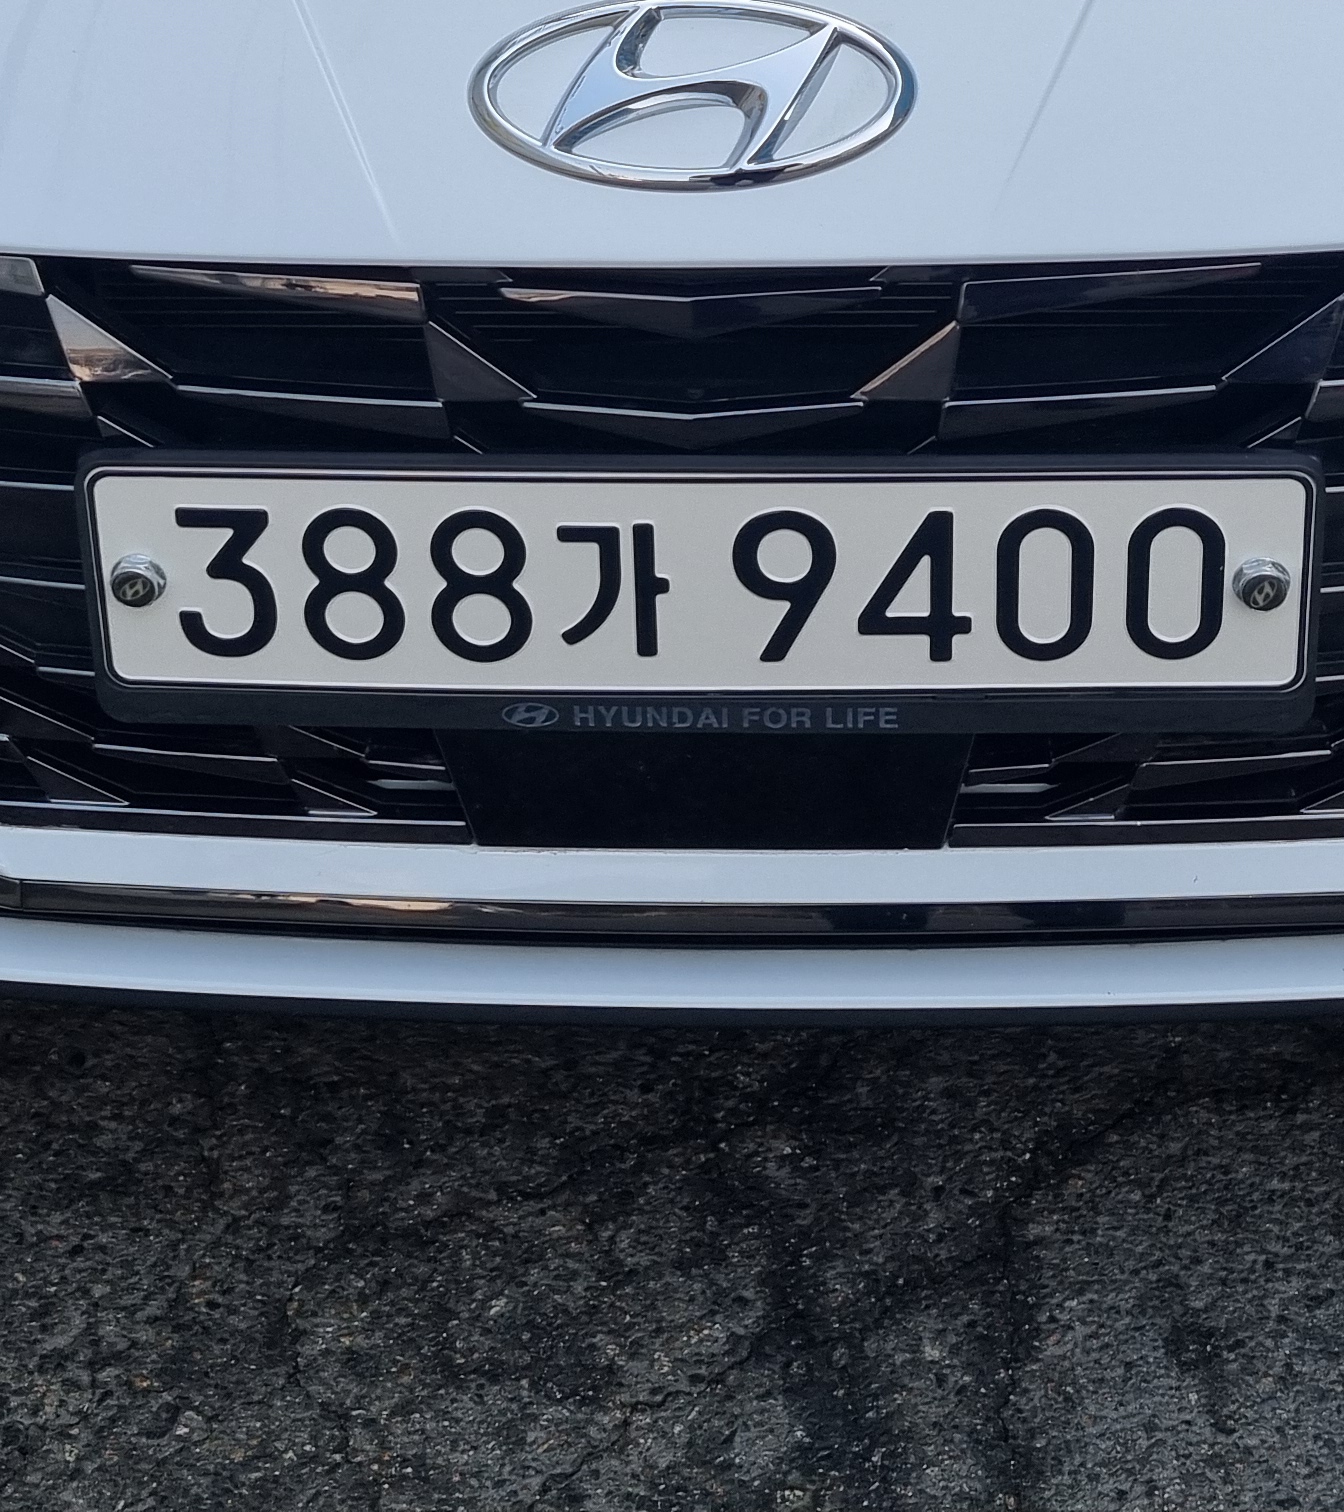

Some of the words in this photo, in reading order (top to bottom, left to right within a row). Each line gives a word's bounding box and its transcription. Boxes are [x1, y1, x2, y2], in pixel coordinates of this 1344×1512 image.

[173, 506, 671, 663] 388가
[731, 506, 1228, 663] 9400
[573, 705, 728, 728] HYUNDAI
[742, 706, 812, 729] FOR
[825, 706, 899, 729] LIFE
